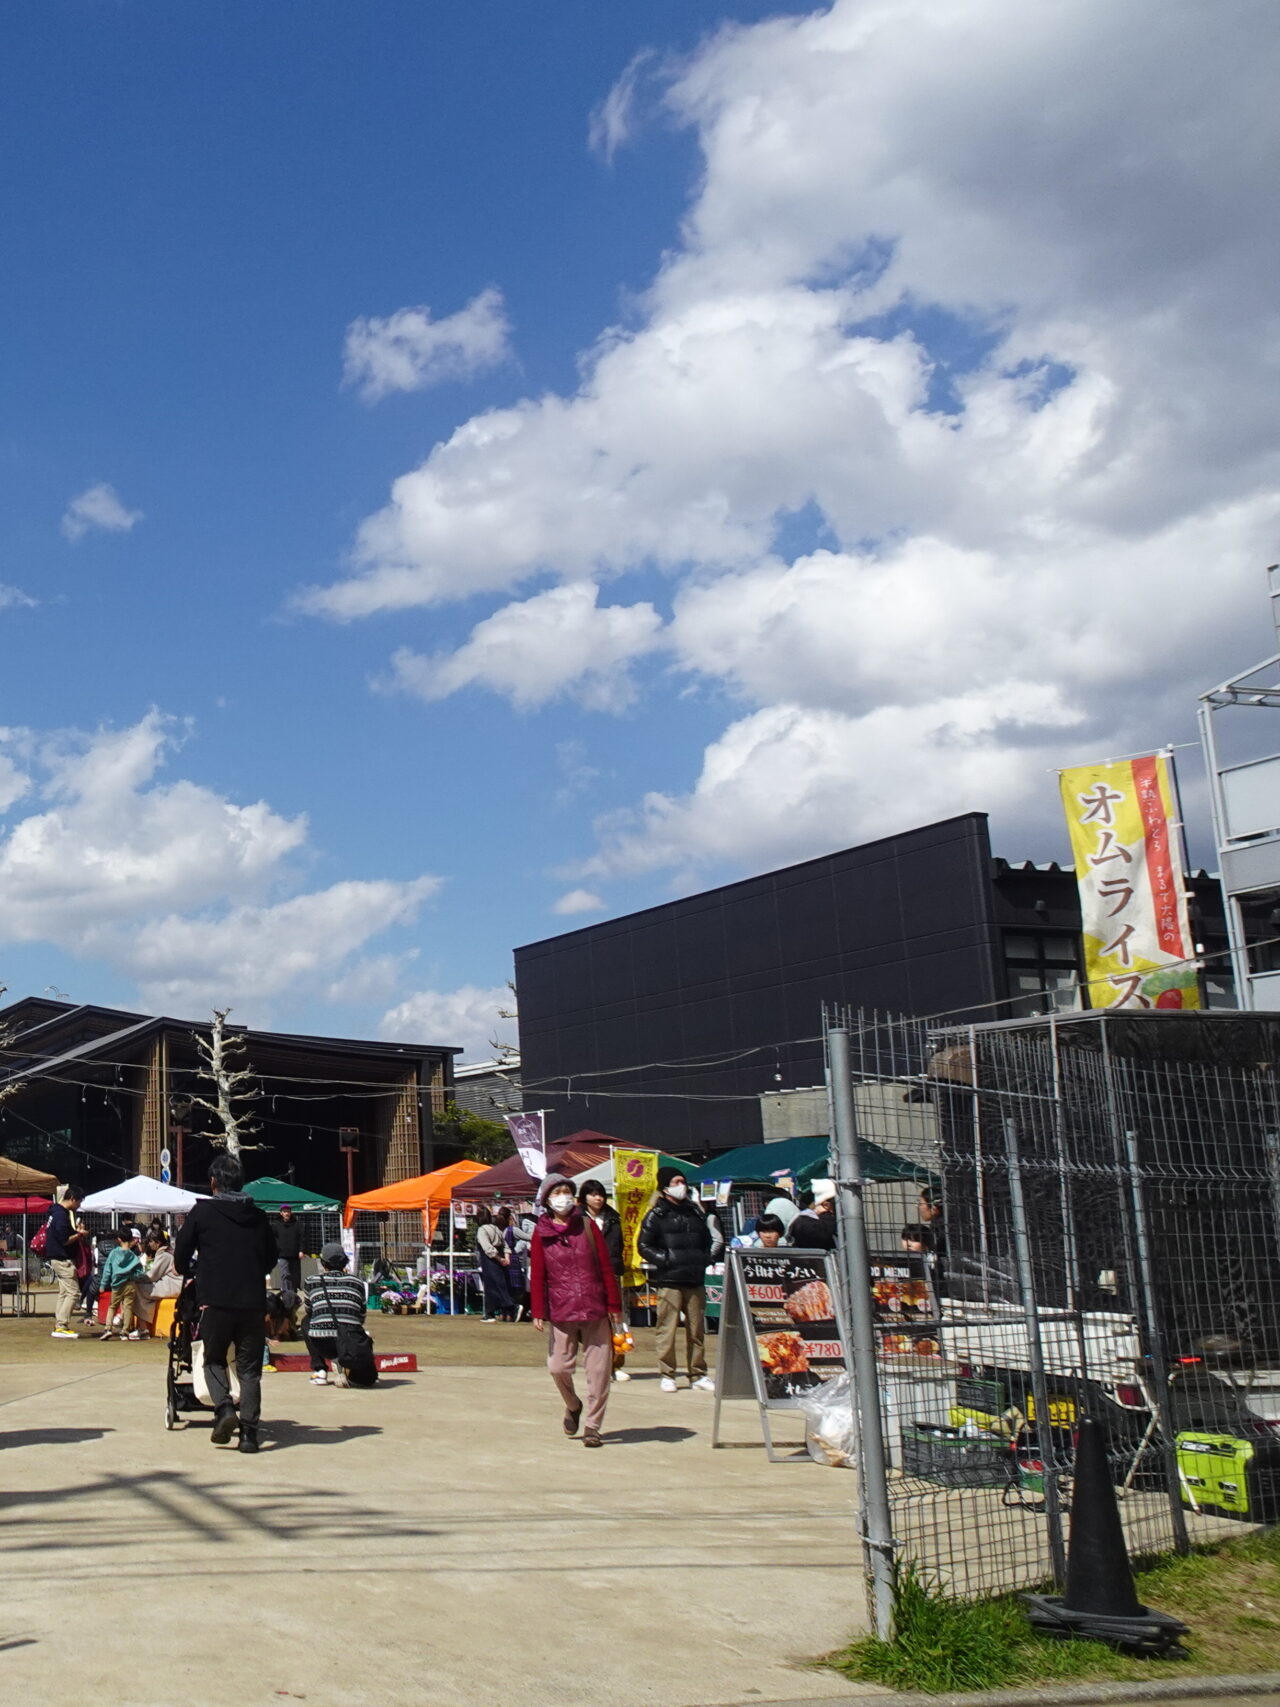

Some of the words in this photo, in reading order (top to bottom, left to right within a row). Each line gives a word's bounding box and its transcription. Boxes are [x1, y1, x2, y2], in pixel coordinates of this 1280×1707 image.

[1080, 785, 1151, 1009] オムライス
[804, 1342, 841, 1357] ¥780
